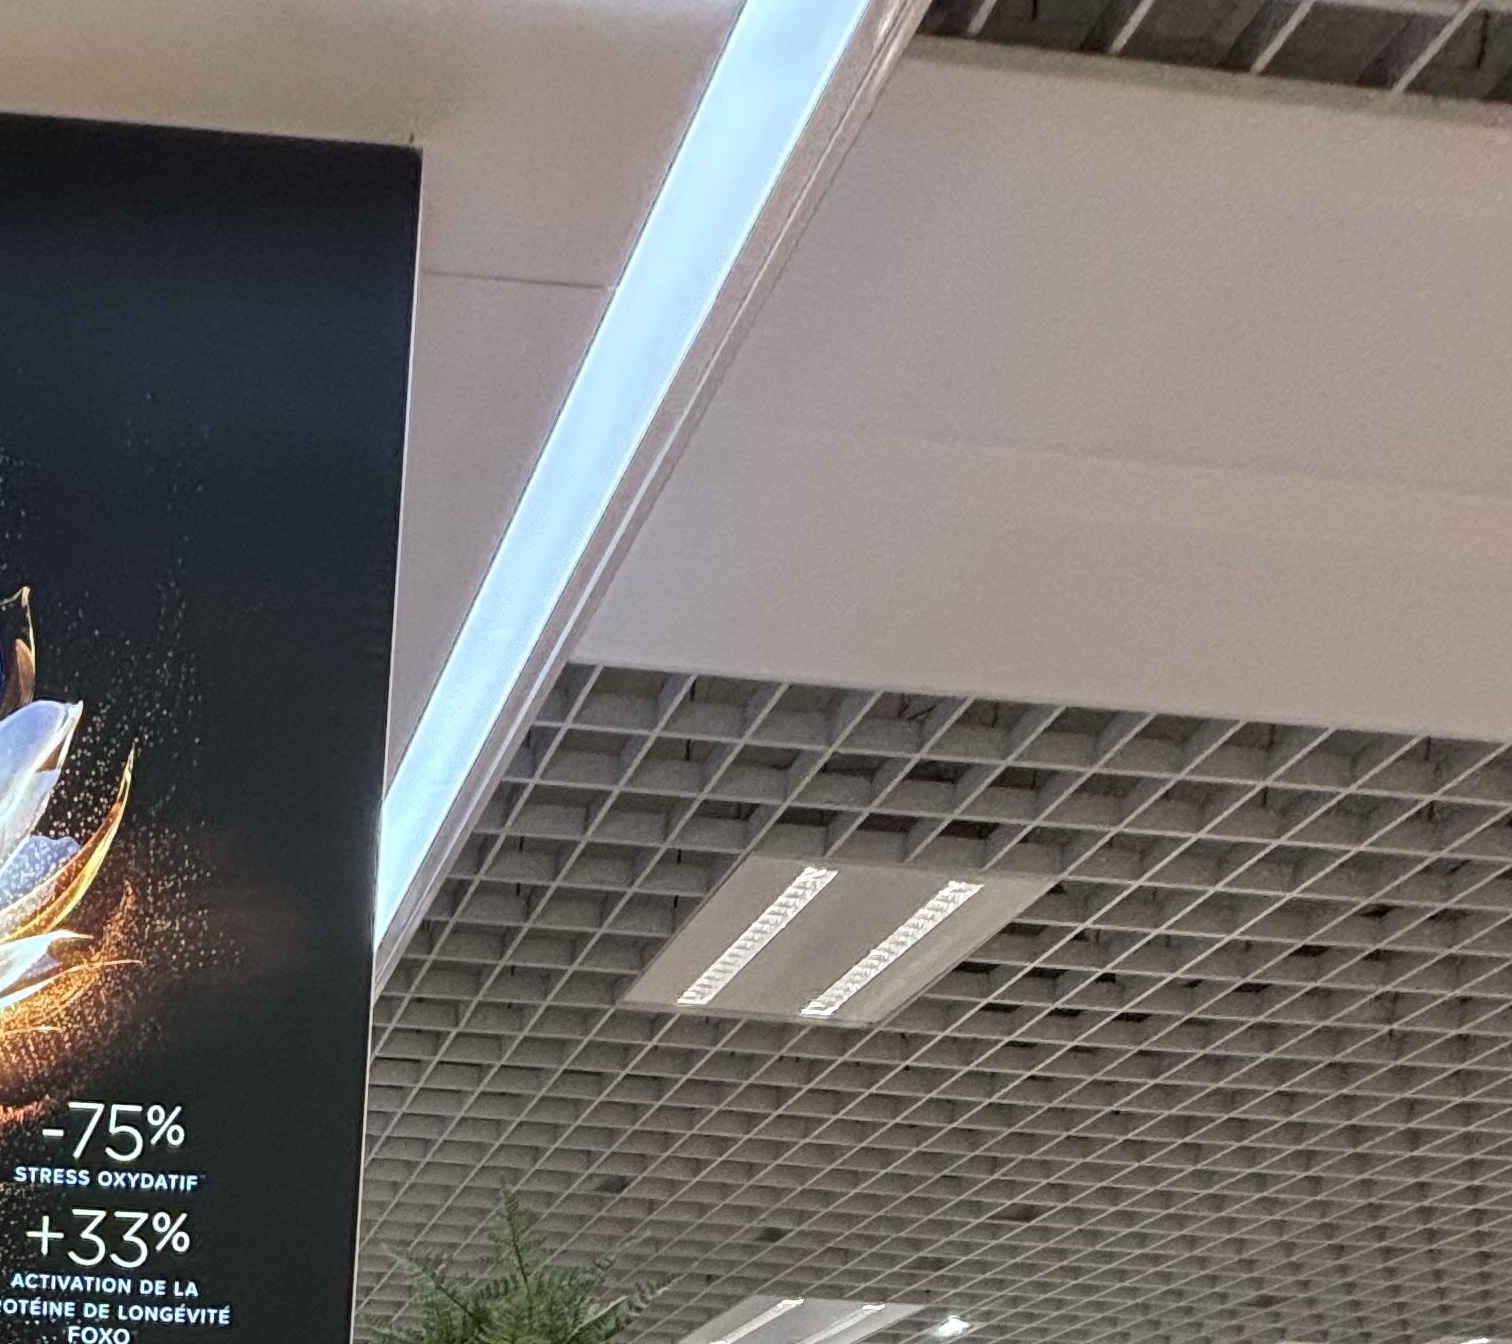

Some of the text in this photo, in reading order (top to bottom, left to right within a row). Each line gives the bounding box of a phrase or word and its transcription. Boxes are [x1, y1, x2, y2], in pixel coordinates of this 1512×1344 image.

[42, 1101, 186, 1162] -75%
[14, 1166, 198, 1191] STRESS OXYDATIF
[26, 1208, 190, 1268] +33%
[11, 1273, 198, 1298] ACTIVATION DE LA
[84, 1303, 109, 1319] DE
[118, 1303, 231, 1325] LONGÉVITÉ
